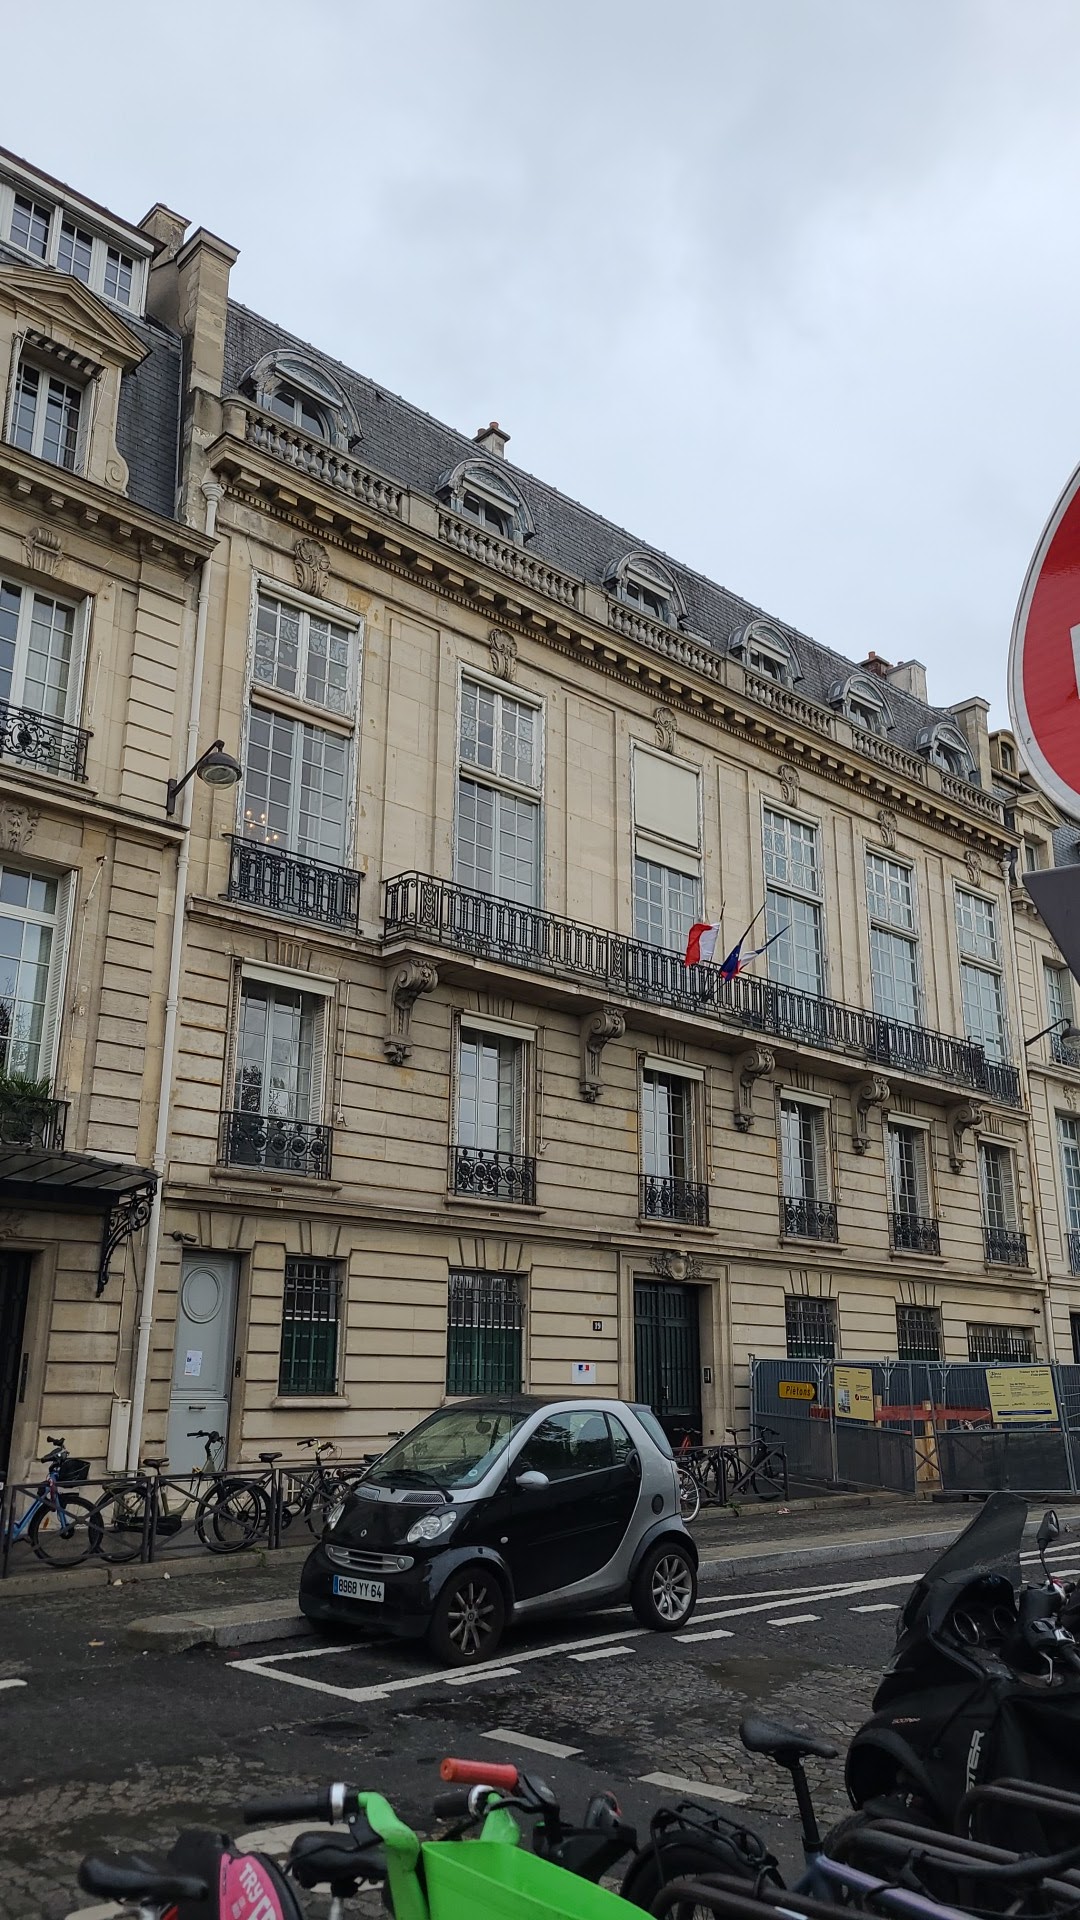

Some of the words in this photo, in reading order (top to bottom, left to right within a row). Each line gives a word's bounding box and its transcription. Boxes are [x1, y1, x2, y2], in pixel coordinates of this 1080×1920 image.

[338, 1579, 357, 1595] 8968
[359, 1582, 369, 1597] YY
[370, 1584, 382, 1599] 64
[239, 1862, 264, 1903] TRY
